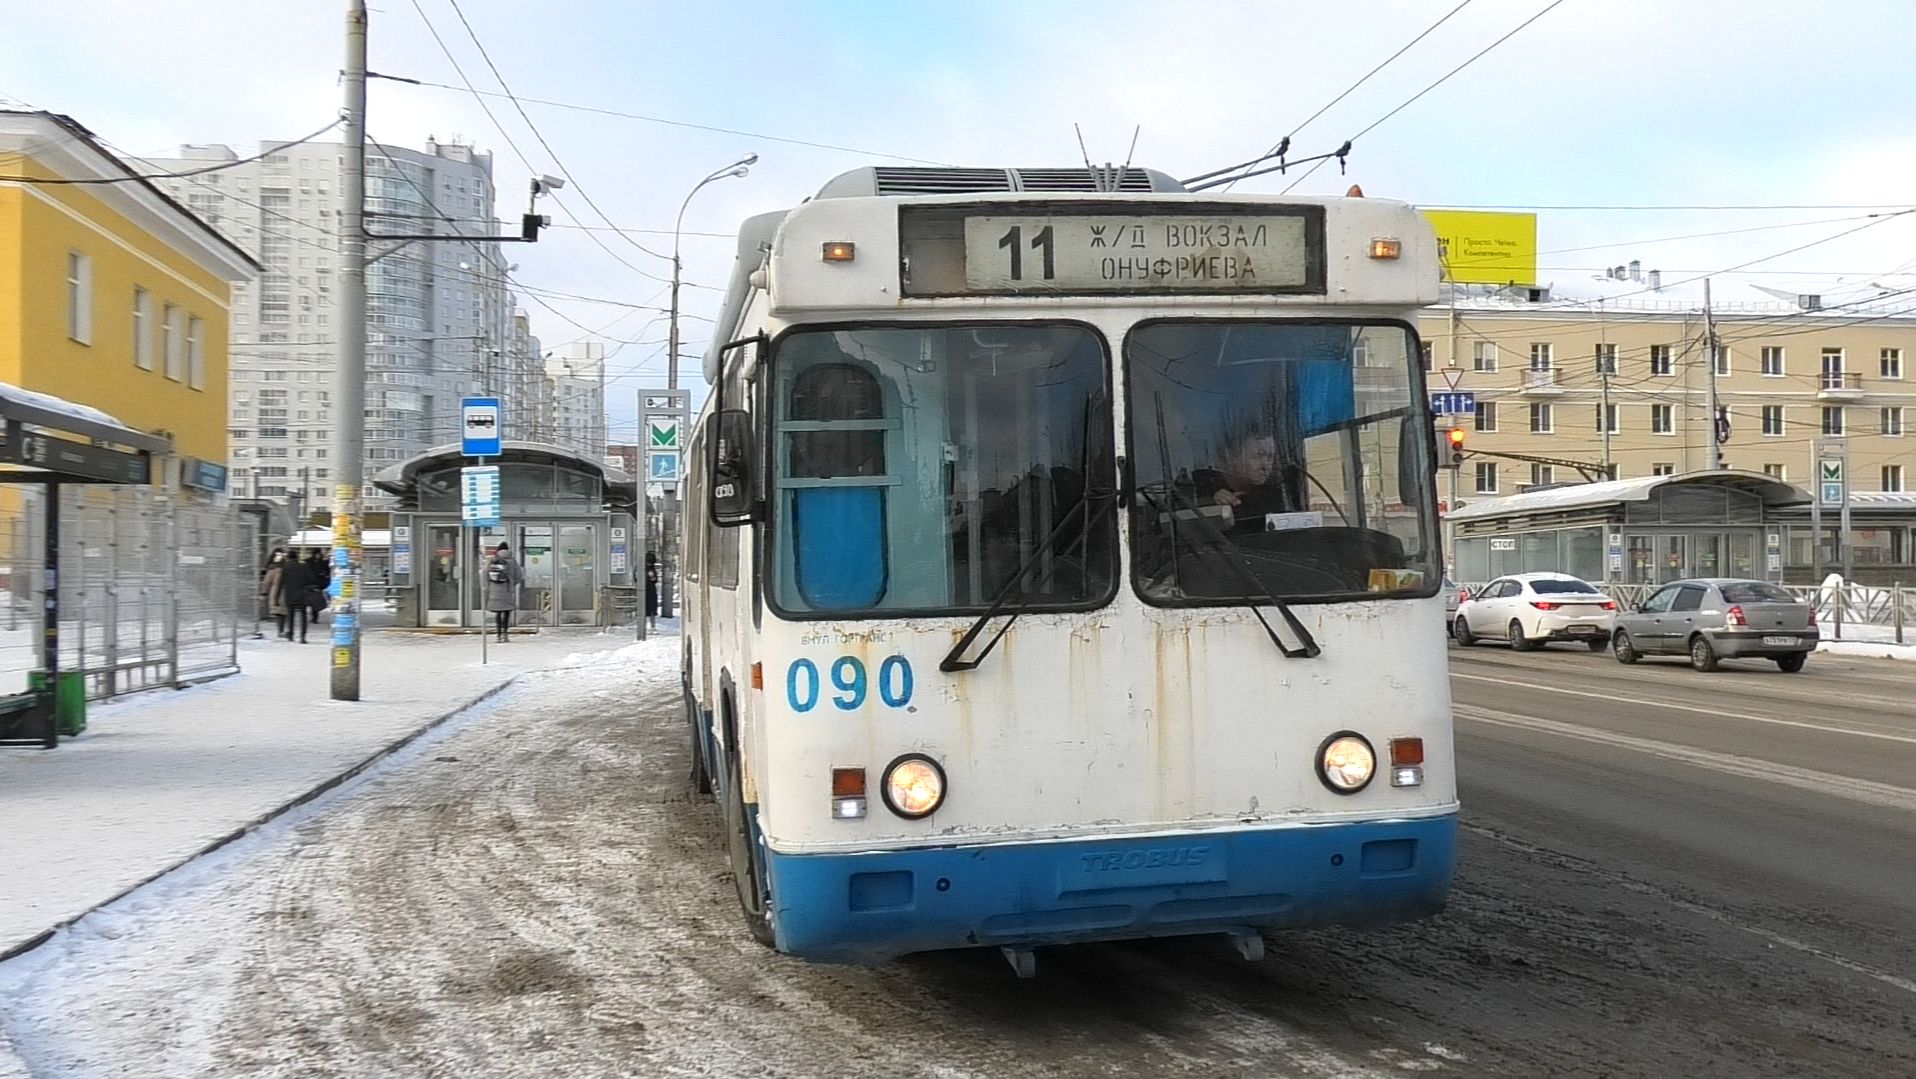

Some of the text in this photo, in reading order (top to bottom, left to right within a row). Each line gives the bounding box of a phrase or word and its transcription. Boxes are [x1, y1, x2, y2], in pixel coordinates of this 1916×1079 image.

[1090, 225, 1267, 249] Ж/Д ВОКЗАЛ
[999, 226, 1055, 281] 11
[1101, 255, 1256, 280] ОНУФРИЕВА
[788, 655, 914, 713] 090
[1081, 846, 1209, 873] TROBUS
